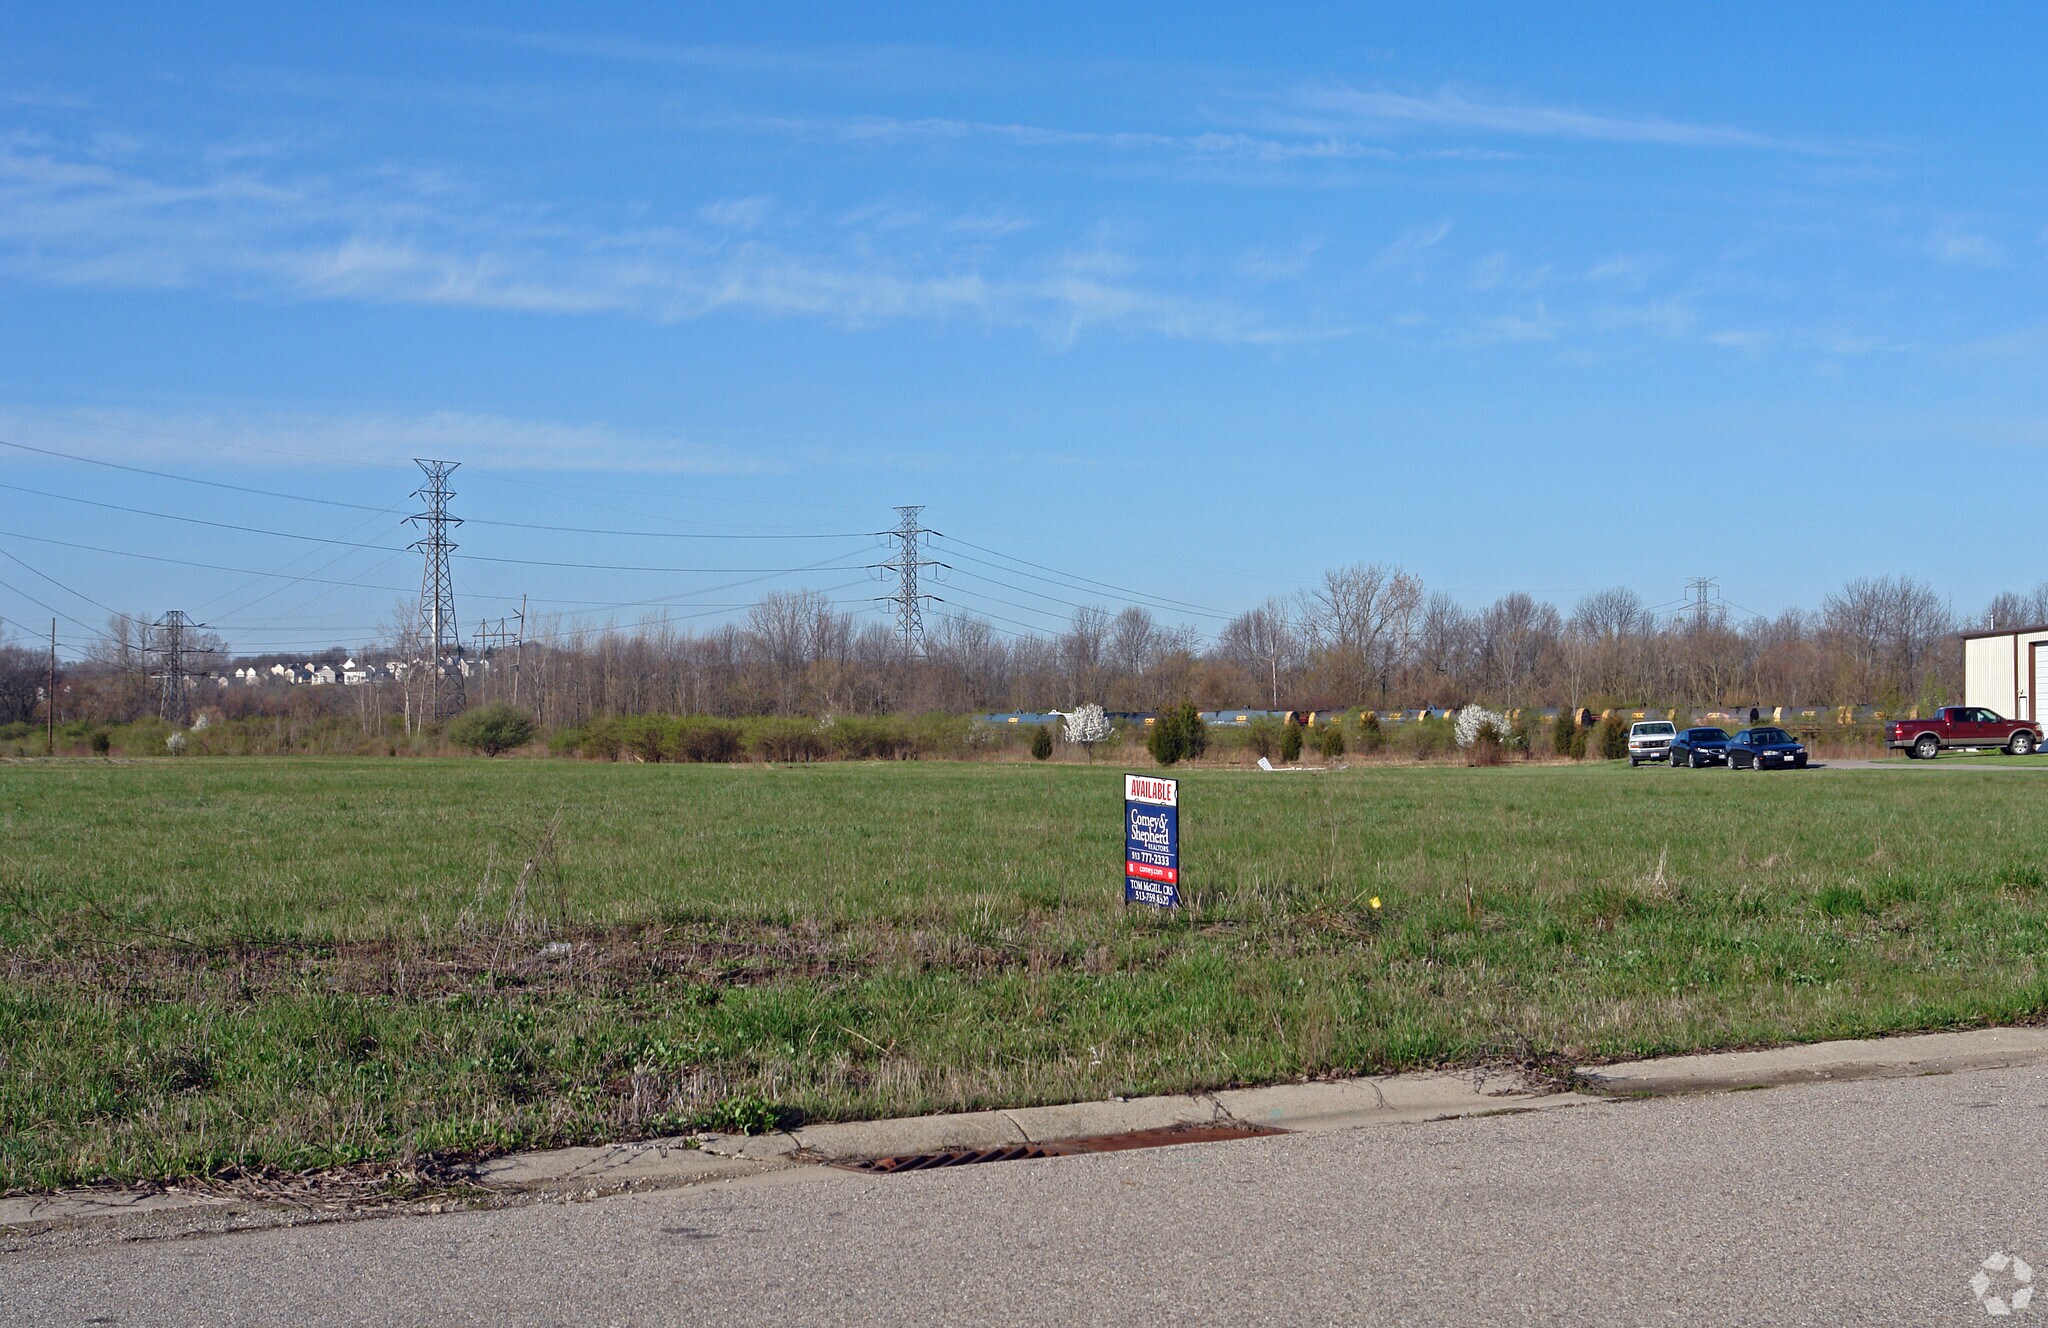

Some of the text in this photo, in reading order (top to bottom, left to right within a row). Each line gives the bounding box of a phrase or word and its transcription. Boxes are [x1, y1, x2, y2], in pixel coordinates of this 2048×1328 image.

[1131, 779, 1172, 801] AVAILABLE
[1131, 824, 1170, 847] Shepherd
[1132, 851, 1169, 866] 513 777-2333
[1130, 879, 1142, 890] TOM
